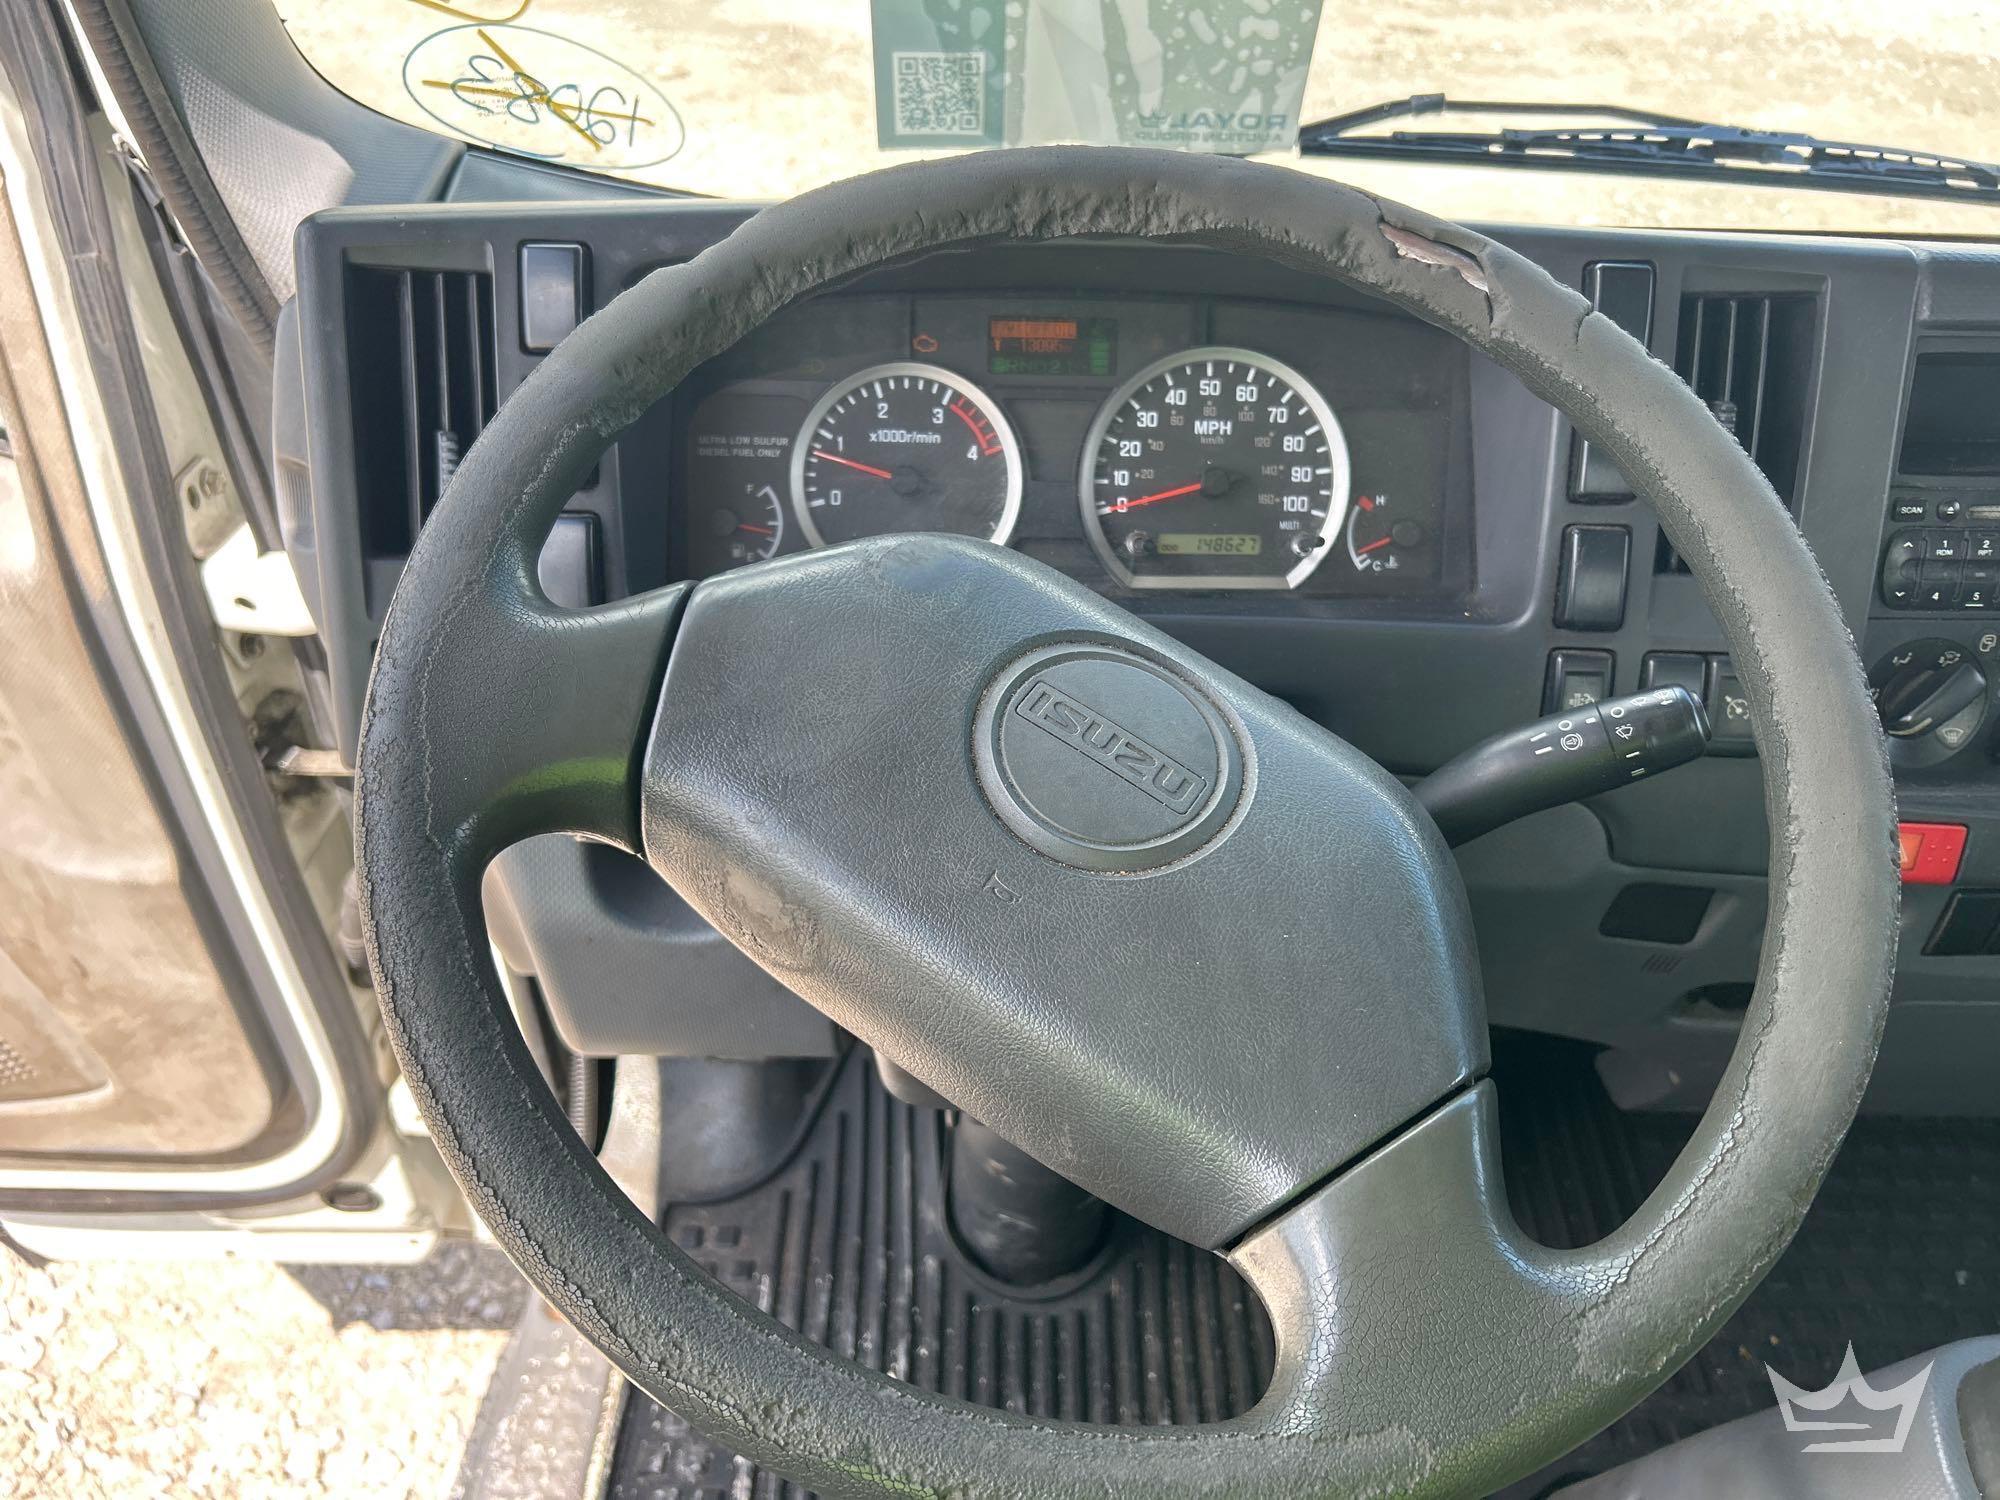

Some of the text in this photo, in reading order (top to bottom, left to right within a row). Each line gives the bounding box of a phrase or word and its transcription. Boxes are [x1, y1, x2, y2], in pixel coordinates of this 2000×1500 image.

[1199, 380, 1220, 396] 50
[1236, 386, 1257, 402] 60
[1165, 389, 1187, 406] 40
[877, 403, 888, 418] 2
[932, 408, 944, 424] 3
[1267, 407, 1288, 423] 70
[1136, 412, 1158, 428] 30
[1194, 420, 1232, 435] MPH
[730, 437, 750, 445] LOW
[753, 438, 789, 446] SULFUR
[837, 436, 843, 451] 1
[1119, 441, 1141, 457] 20
[1283, 436, 1304, 452] 80
[732, 448, 754, 457] FUEL
[757, 449, 781, 458] ONLY
[967, 446, 978, 461] 4
[1113, 470, 1129, 486] 10
[1140, 469, 1154, 479] 20
[1291, 466, 1312, 483] 90
[746, 484, 754, 494] F
[830, 490, 841, 506] 0
[1117, 498, 1128, 513] 0
[1283, 496, 1308, 512] 100
[1375, 495, 1385, 506] H
[1901, 506, 1924, 514] SCAN
[1197, 537, 1257, 553] 148627
[1942, 540, 1948, 548] 1
[1983, 540, 1991, 548] 2
[1372, 560, 1382, 571] C
[1932, 592, 1940, 600] 4
[1972, 592, 1981, 601] 5
[1028, 690, 1195, 801] ISUZU
